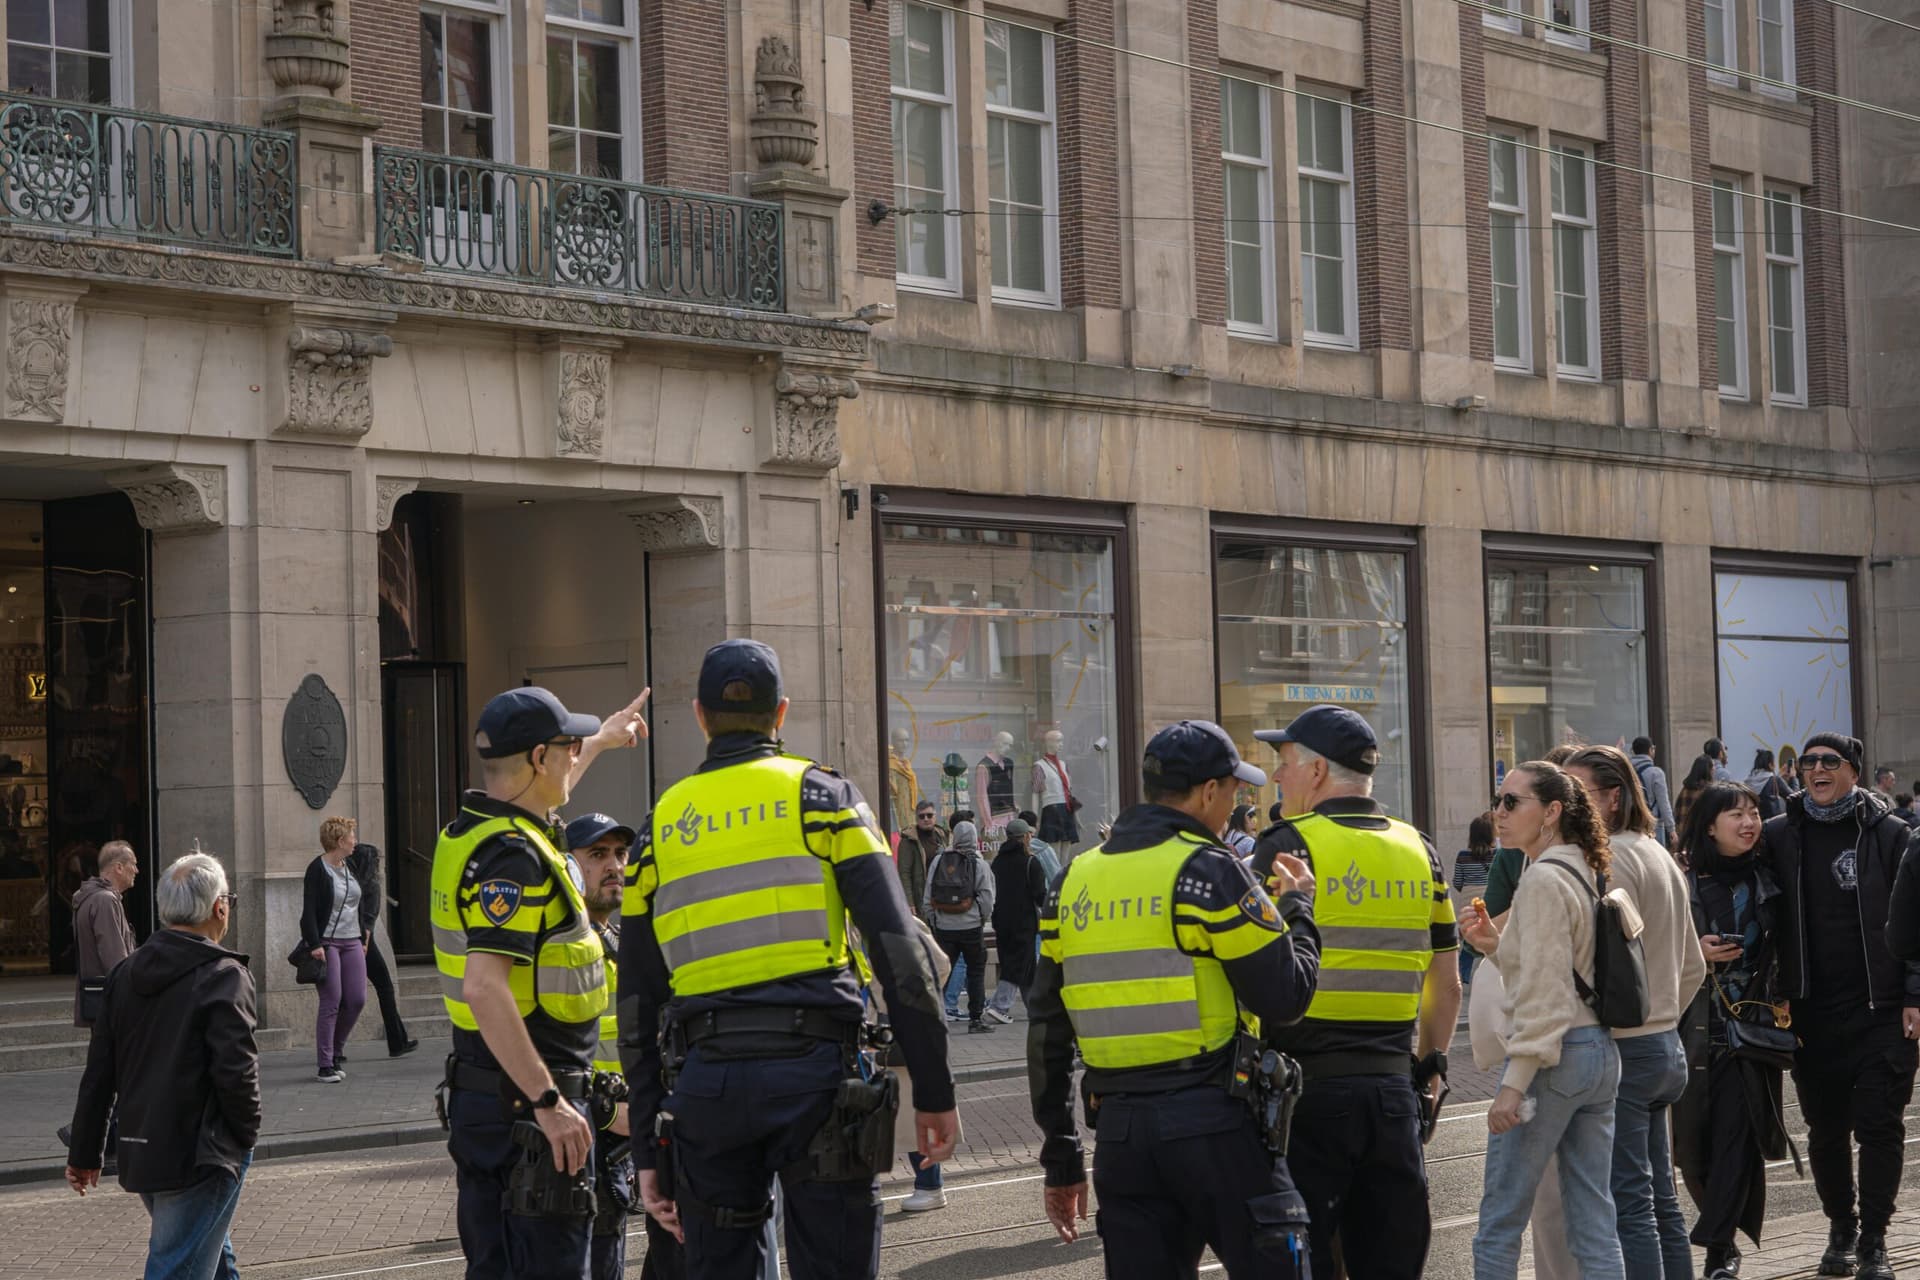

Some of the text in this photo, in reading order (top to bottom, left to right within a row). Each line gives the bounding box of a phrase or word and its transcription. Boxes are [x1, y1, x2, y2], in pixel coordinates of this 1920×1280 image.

[1287, 686, 1300, 700] DE
[661, 800, 788, 846] POLITIE
[483, 884, 518, 895] POLITIE
[1327, 865, 1430, 906] POLITIE
[1061, 887, 1163, 931] POLITIE
